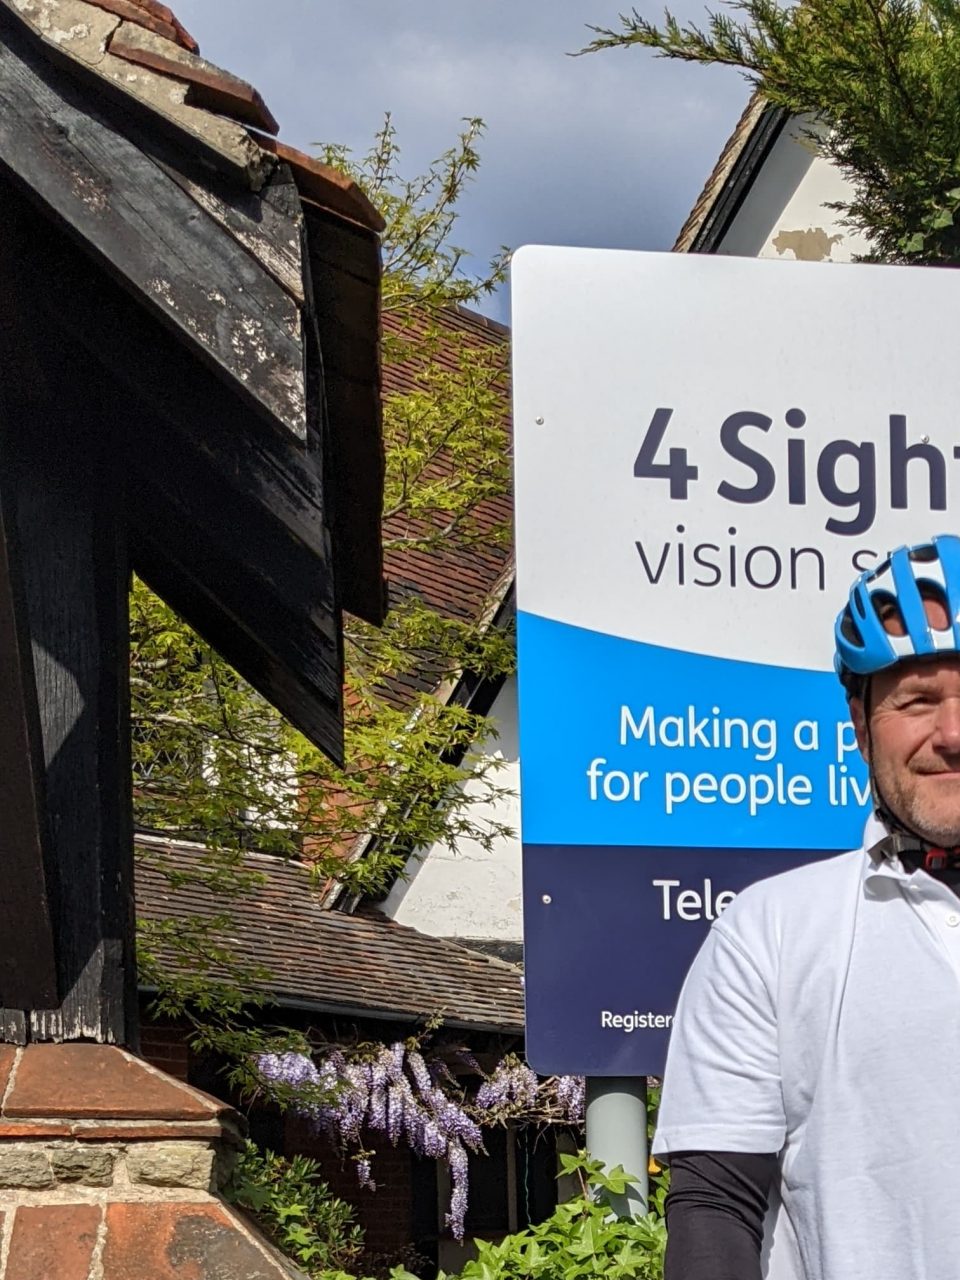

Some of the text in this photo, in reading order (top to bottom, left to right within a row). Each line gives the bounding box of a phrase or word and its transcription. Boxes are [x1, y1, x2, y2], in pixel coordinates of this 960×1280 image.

[634, 408, 698, 500] 4
[635, 524, 826, 591] vision
[619, 705, 777, 761] Making
[793, 720, 820, 751] a
[586, 758, 649, 801] for
[665, 763, 813, 816] people
[828, 764, 872, 807] liv
[653, 878, 738, 921] Tele
[601, 1010, 676, 1033] Register
